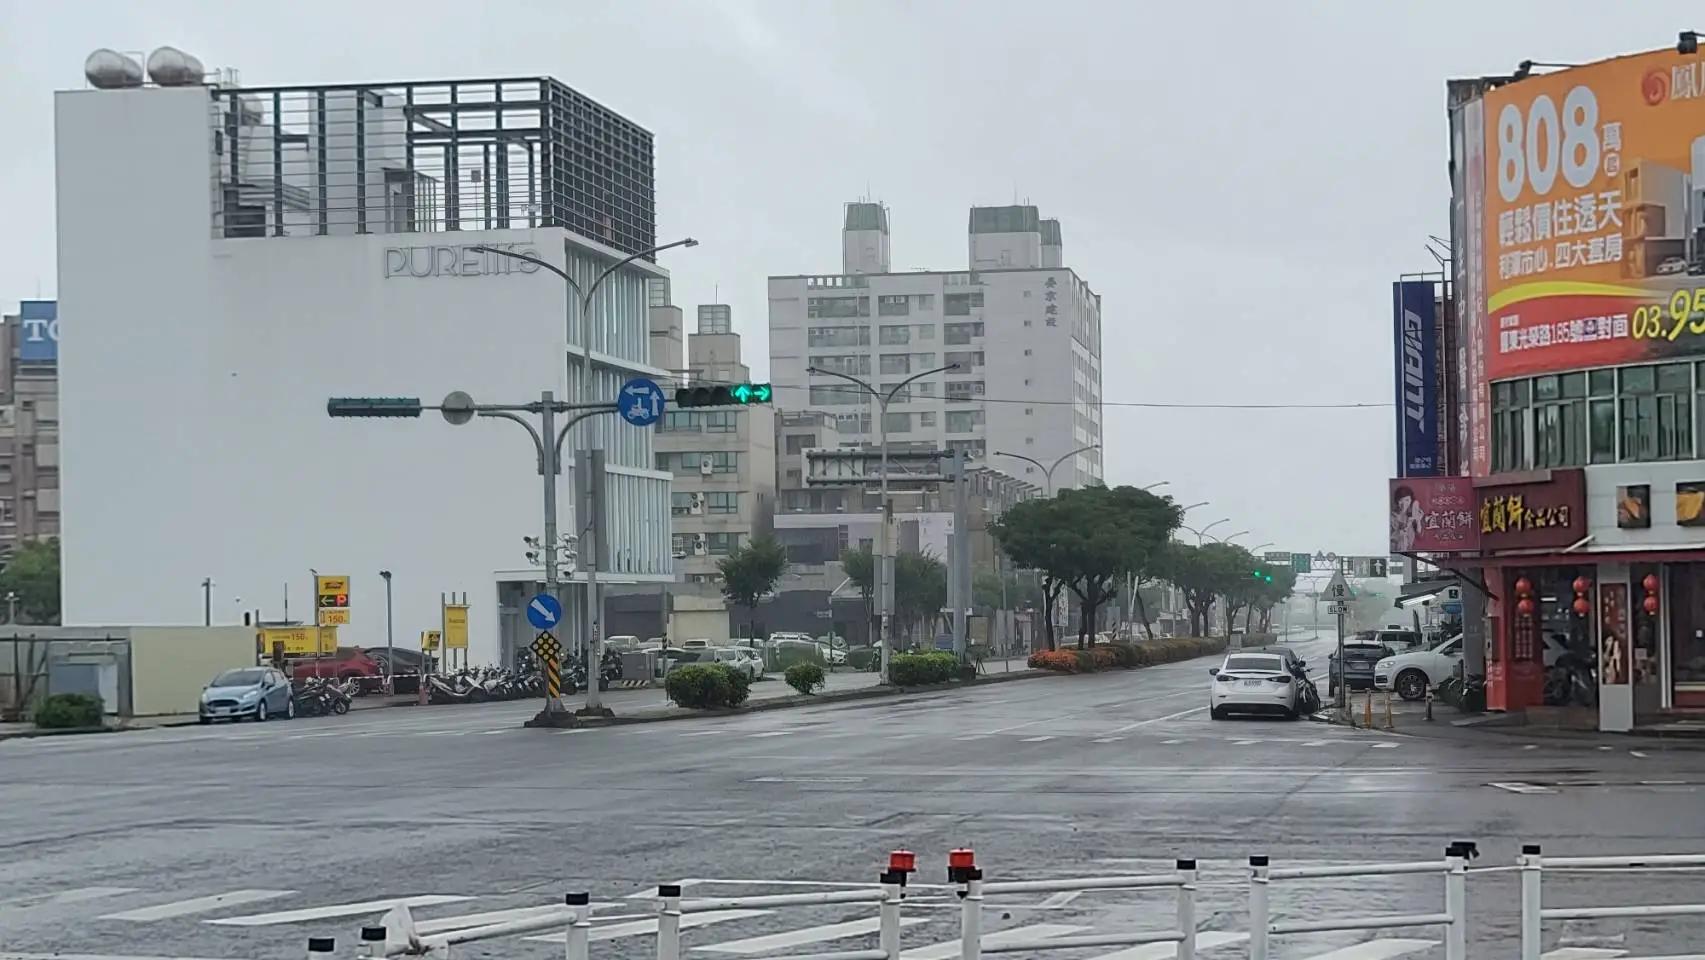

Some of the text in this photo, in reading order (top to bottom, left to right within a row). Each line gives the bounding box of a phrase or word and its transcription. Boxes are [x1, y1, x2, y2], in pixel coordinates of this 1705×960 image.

[1671, 62, 1705, 100] 鳳
[1498, 86, 1600, 202] 808
[1499, 190, 1623, 247] 輕鬆價住透天
[1404, 309, 1425, 434] GIANT
[1424, 510, 1473, 530] 宜蘭餅
[1332, 584, 1345, 597] 慢
[328, 614, 344, 624] 150
